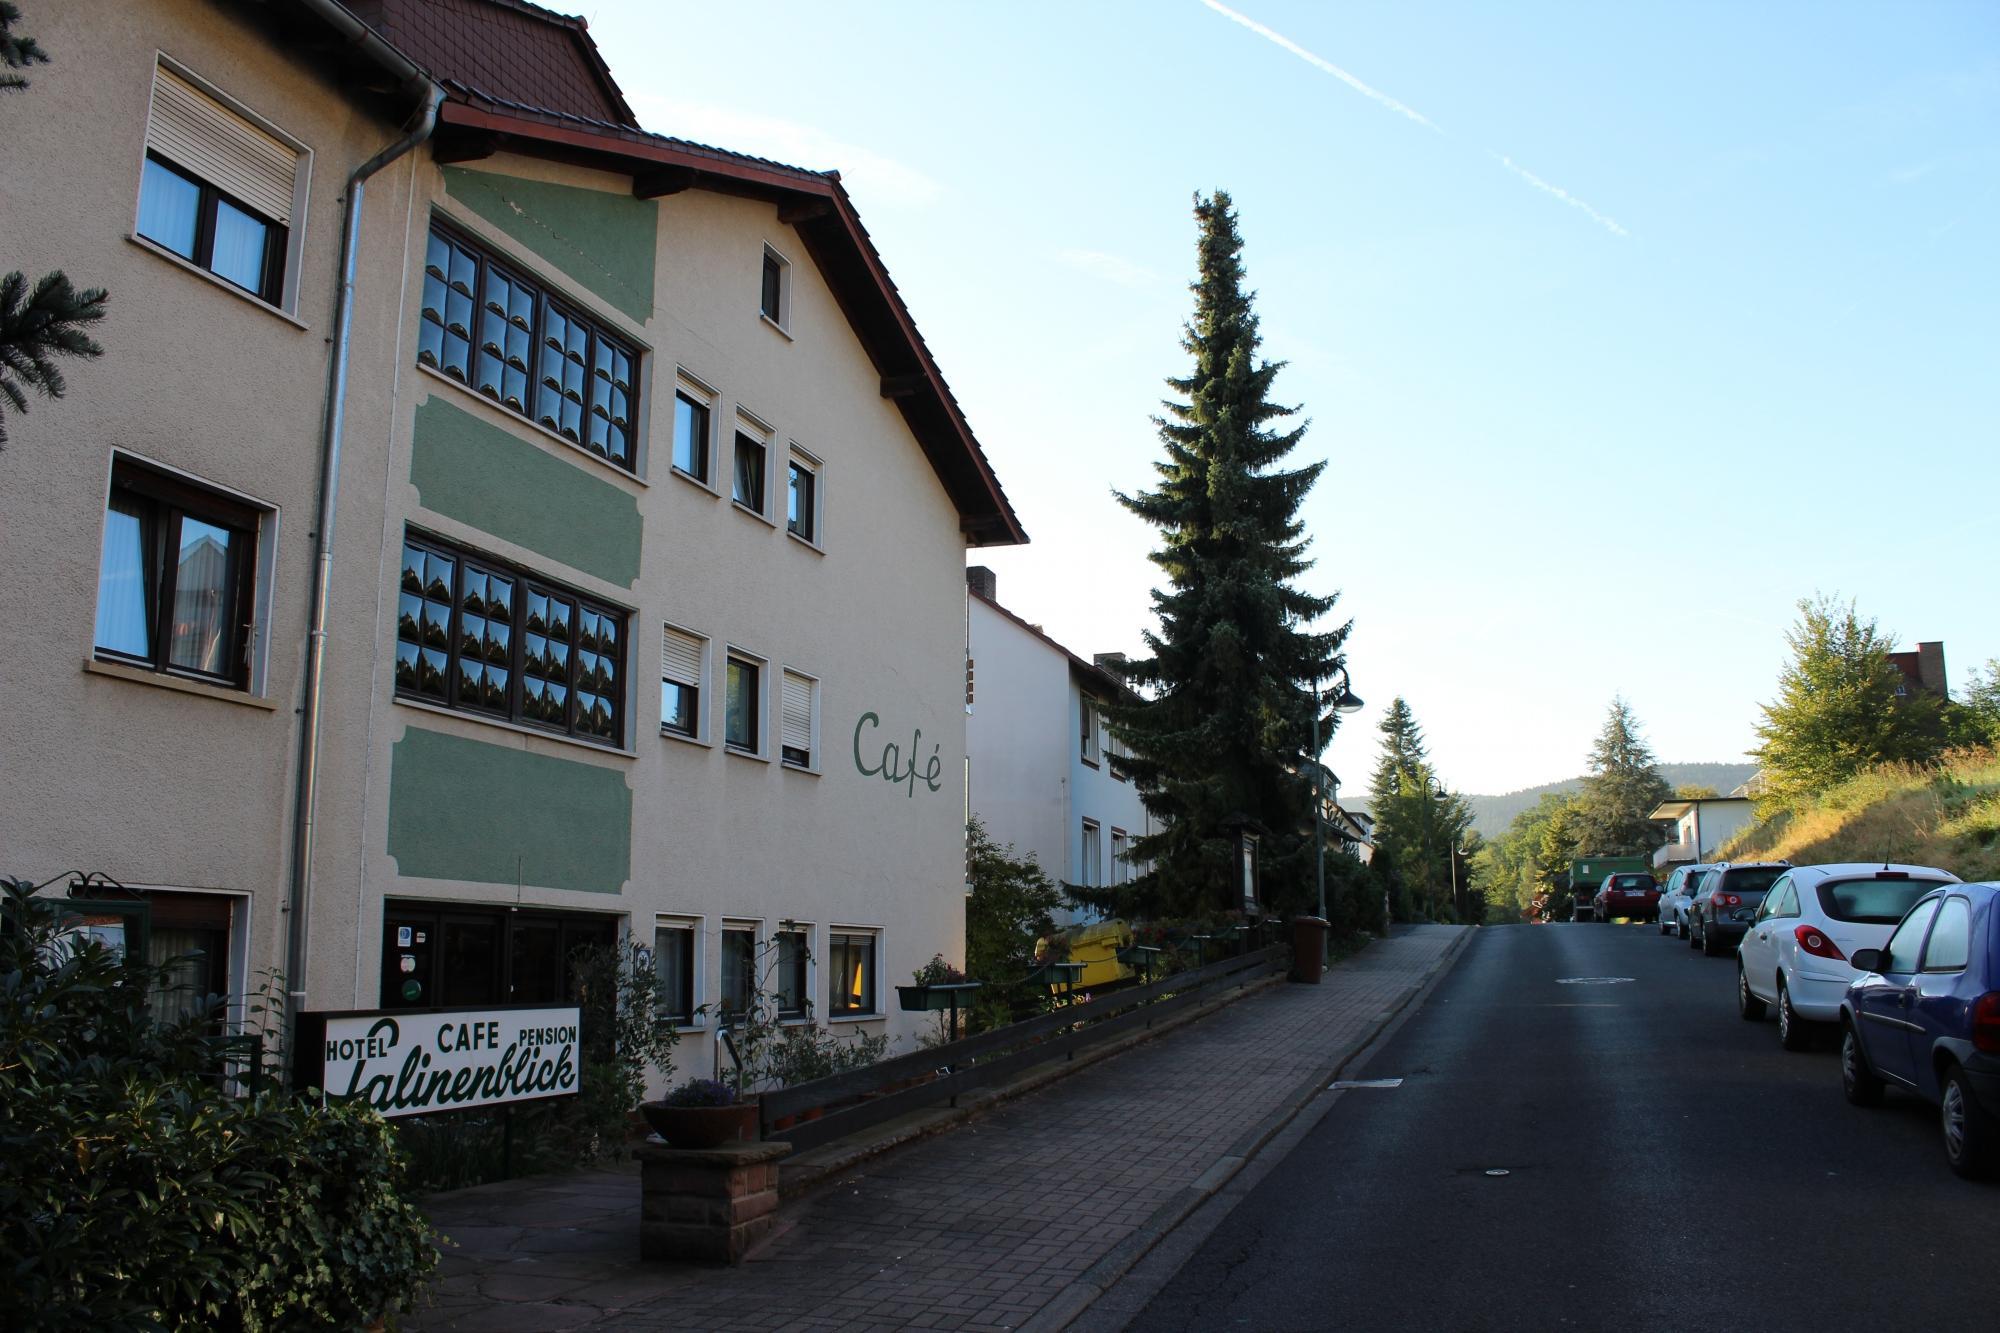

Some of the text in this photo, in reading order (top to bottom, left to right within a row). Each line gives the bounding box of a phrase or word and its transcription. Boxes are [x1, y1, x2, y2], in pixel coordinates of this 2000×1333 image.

[853, 711, 942, 798] Café
[326, 1021, 577, 1061] HOTEL CAFE PENSION
